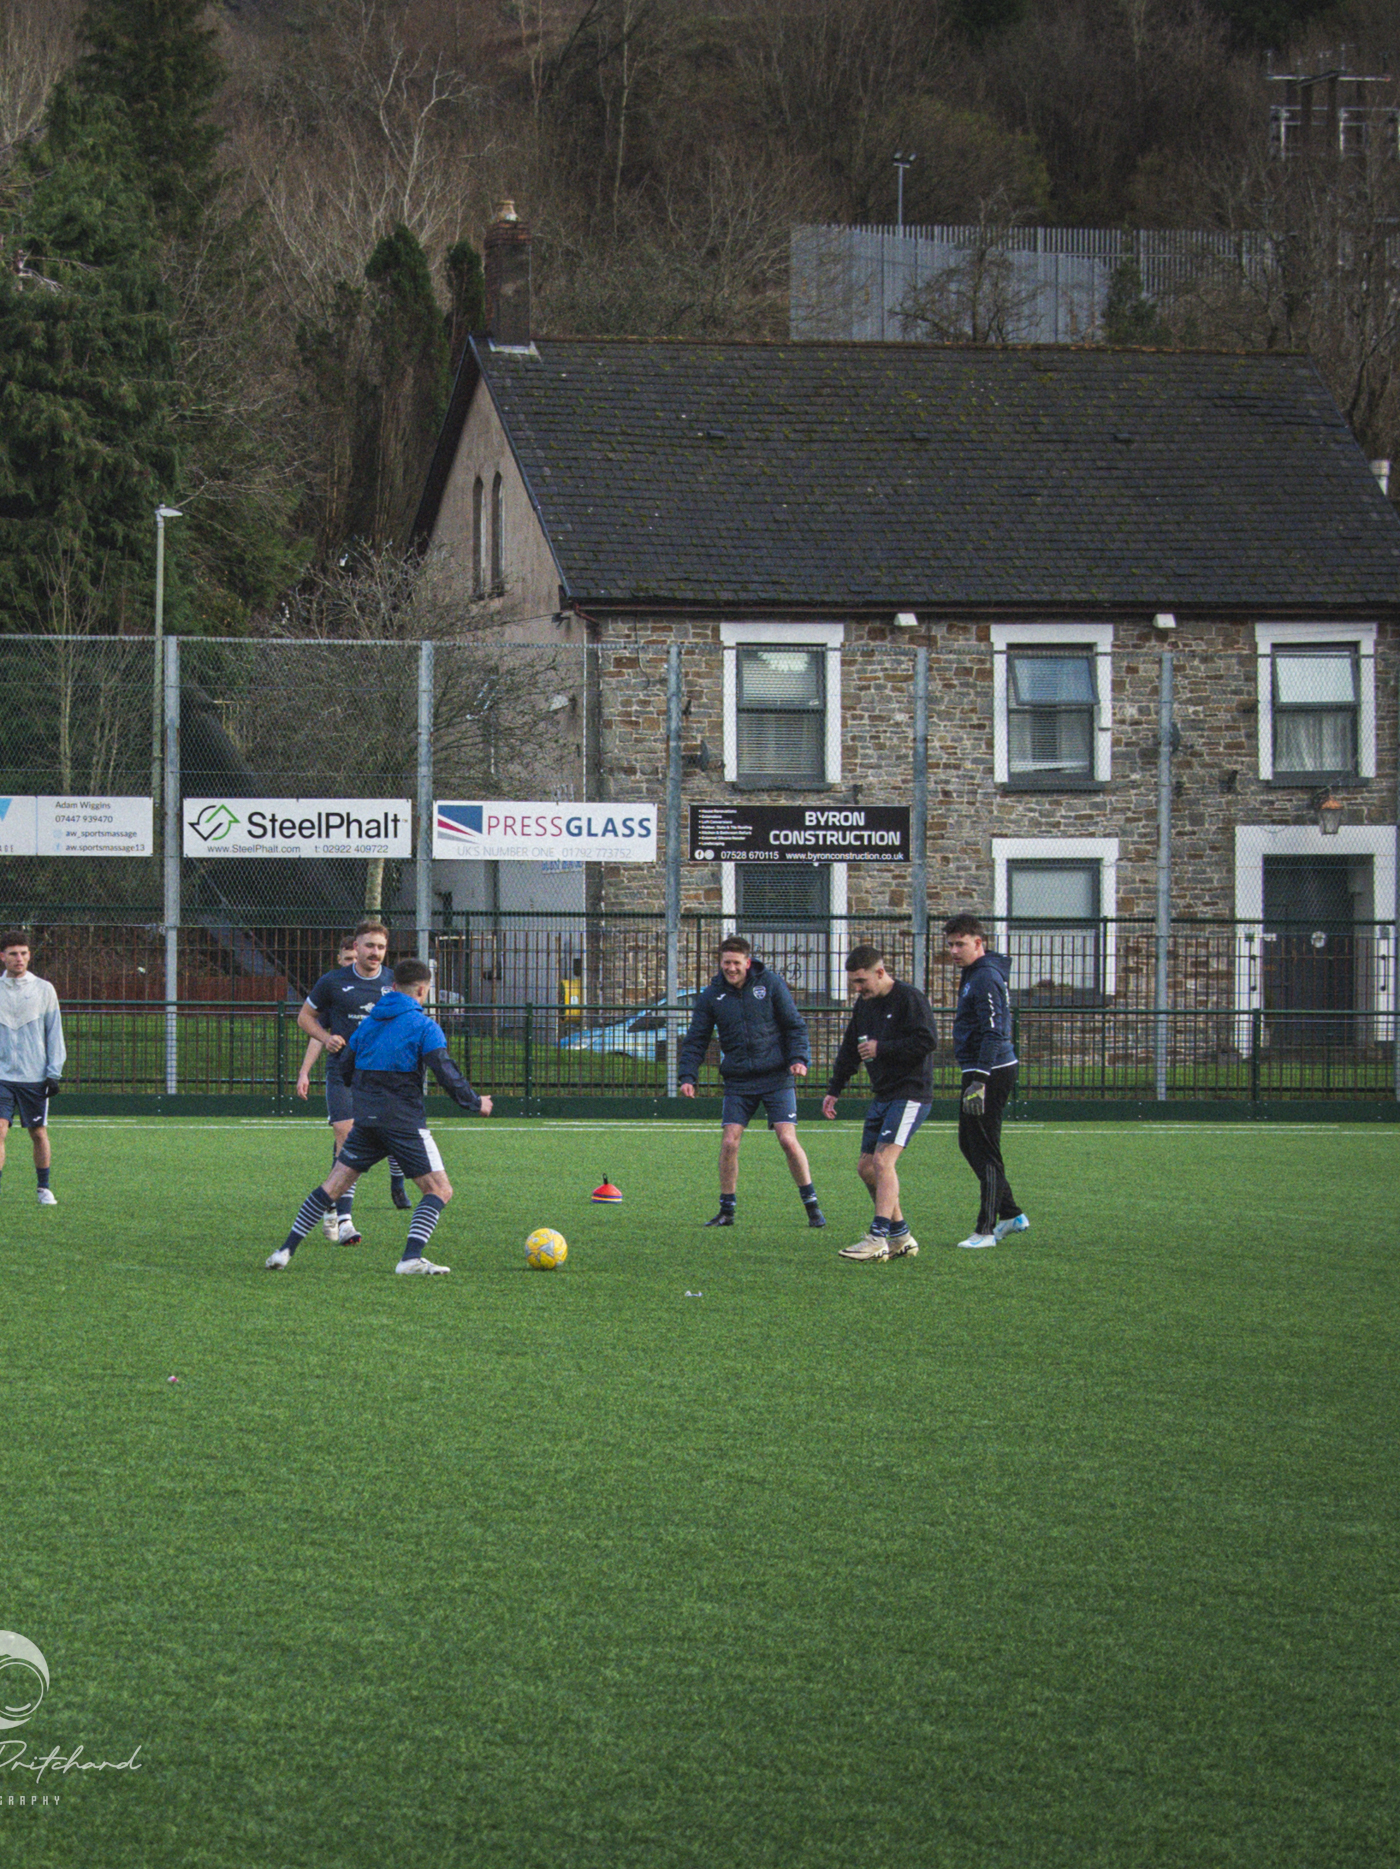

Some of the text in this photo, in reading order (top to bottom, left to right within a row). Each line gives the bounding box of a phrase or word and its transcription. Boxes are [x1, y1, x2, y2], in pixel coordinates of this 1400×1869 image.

[55, 801, 111, 810] Adam Wiggins
[55, 815, 114, 823] 07447 939470
[805, 811, 865, 826] BYRON
[247, 811, 400, 839] SteelPhalt
[769, 830, 900, 846] CONSTRUCTION
[207, 845, 300, 854] www.SteelPhalt.com
[322, 845, 351, 853] 02922
[354, 845, 389, 853] 409722
[483, 846, 530, 857] NUMBER
[531, 847, 555, 858] ONE
[561, 847, 592, 858] 01792
[595, 848, 632, 859] 773752
[720, 851, 904, 861] 07528 670115 www.byronconstruction.co.uk
